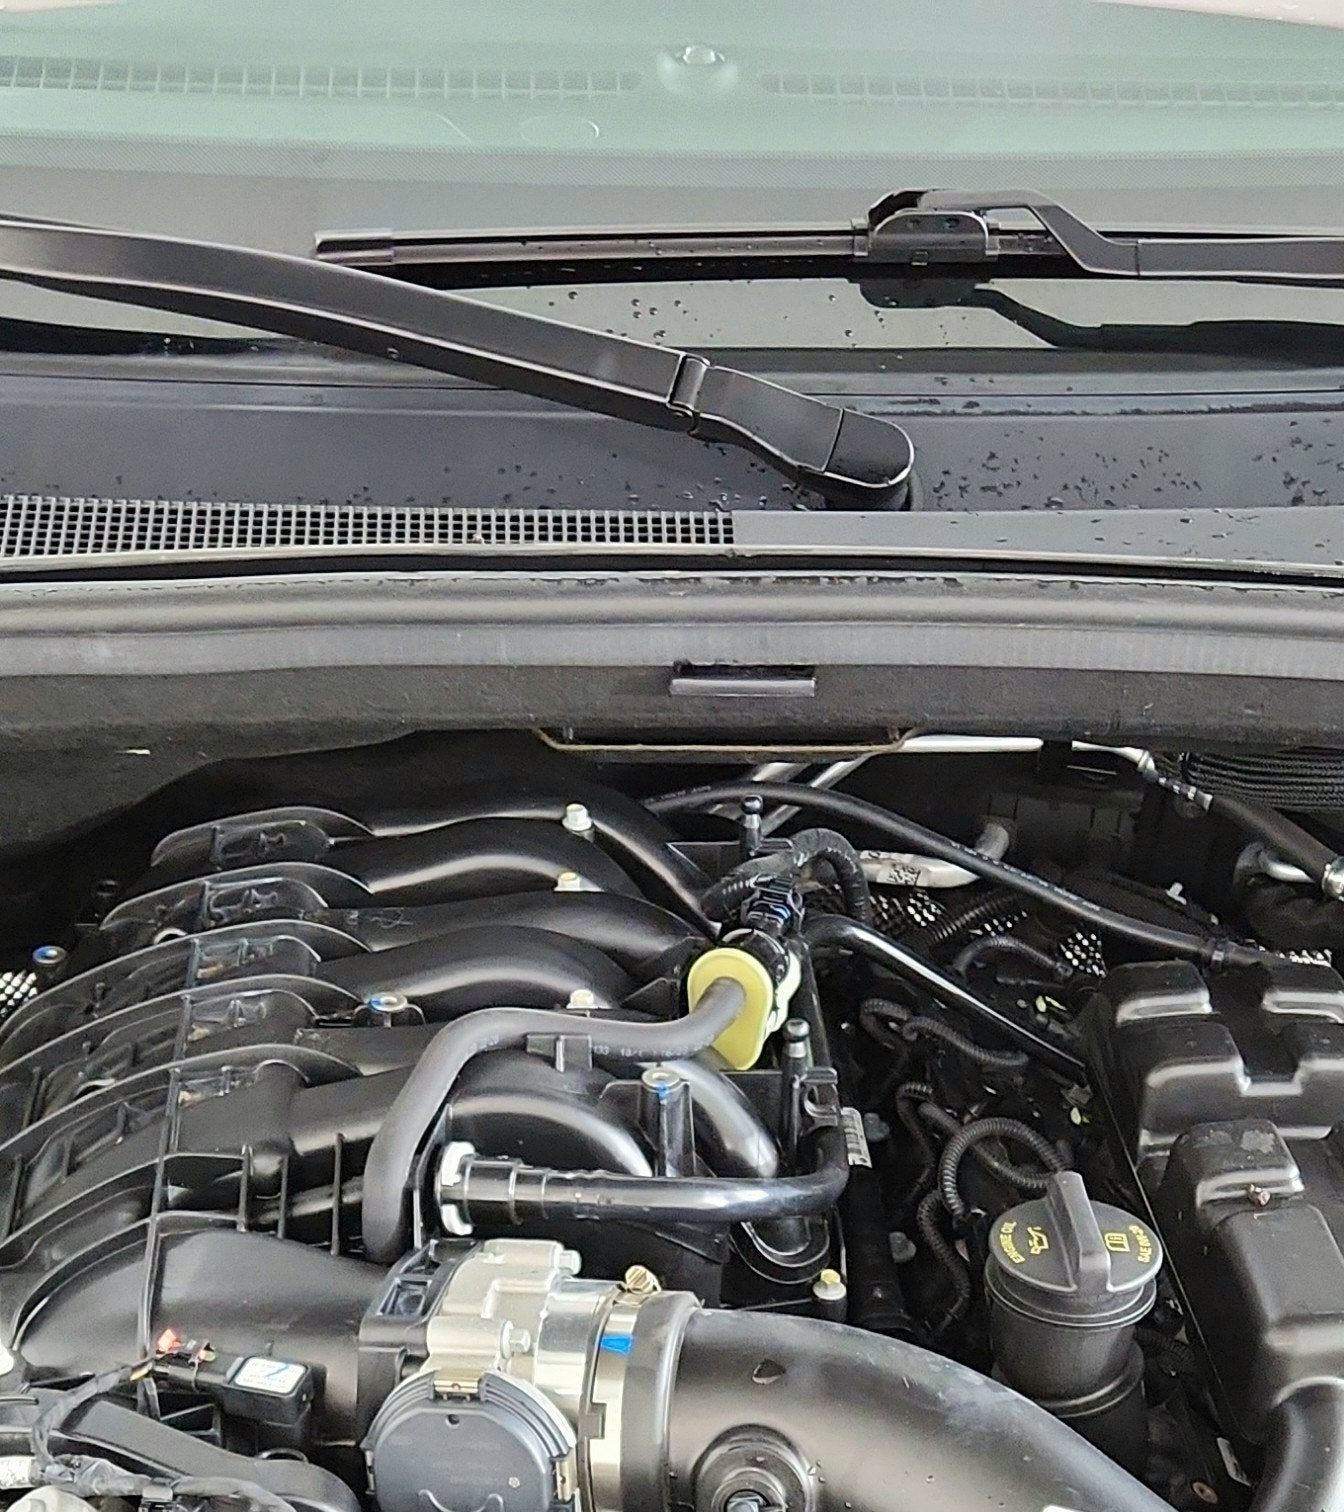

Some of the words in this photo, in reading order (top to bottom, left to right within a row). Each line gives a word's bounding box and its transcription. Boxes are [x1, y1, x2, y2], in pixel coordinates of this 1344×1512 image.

[1001, 1221, 1018, 1234] OIL
[999, 1233, 1026, 1264] ENGINE
[1137, 1247, 1153, 1263] SAE
